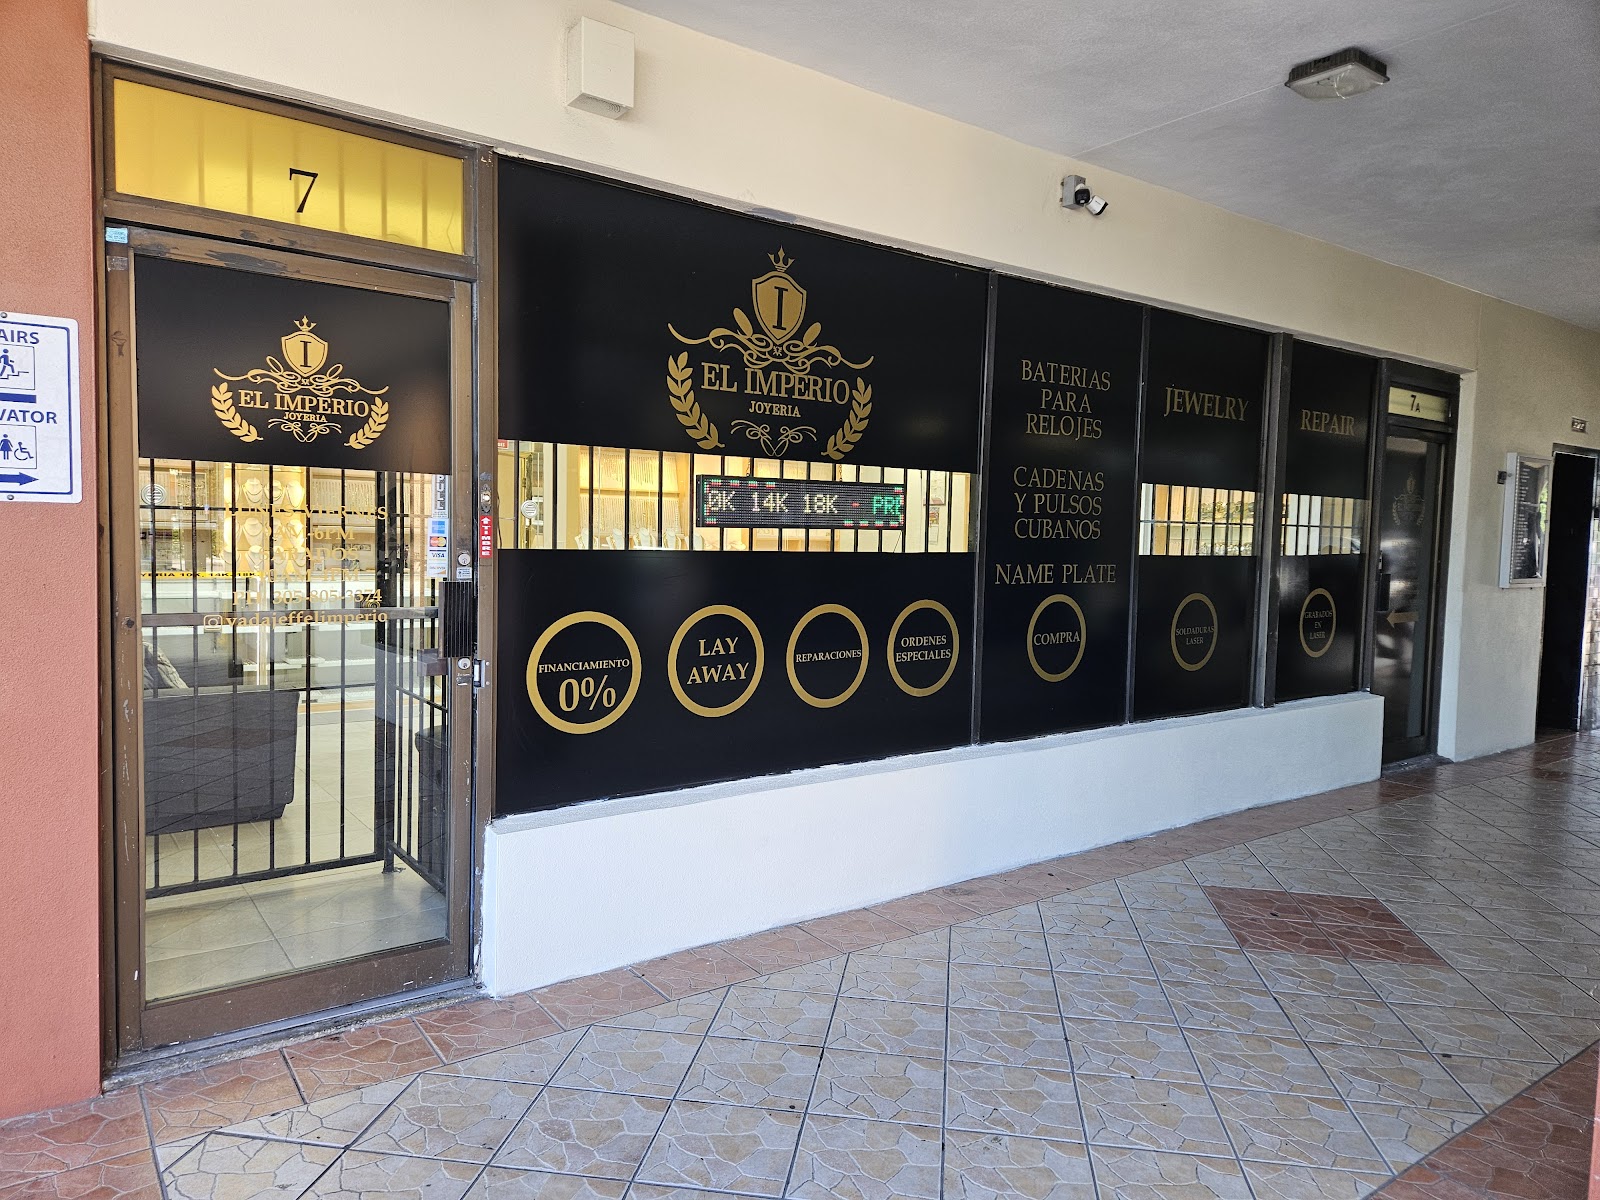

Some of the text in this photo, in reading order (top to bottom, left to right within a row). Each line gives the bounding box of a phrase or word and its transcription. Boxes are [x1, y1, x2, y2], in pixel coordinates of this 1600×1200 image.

[289, 167, 319, 214] 7
[772, 285, 789, 331] I
[299, 340, 312, 368] I
[701, 362, 850, 405] EL IMPERIO
[1021, 359, 1111, 391] BATERIAS
[238, 389, 369, 418] EL IMPERIO
[749, 400, 801, 418] JOYERIA
[1040, 388, 1092, 414] PARA
[1164, 386, 1249, 422] JEWELRY
[1410, 394, 1421, 413] 7A
[283, 411, 328, 423] JOYERIA
[1026, 412, 1102, 441] RELOJES
[1300, 409, 1355, 437] REPAIR
[1013, 465, 1105, 492] CADENAS
[752, 491, 789, 513] 14K
[803, 493, 838, 514] 18K
[1014, 492, 1102, 516] Y PULSOS
[1014, 517, 1101, 540] CUBANOS
[481, 525, 492, 556] TIMBRE
[995, 563, 1117, 585] NAME PLATE
[273, 588, 383, 605] 305-805-3374
[1175, 625, 1215, 636] SOLDADURAS
[1314, 621, 1323, 629] EN
[698, 636, 739, 657] LAY
[901, 635, 947, 648] ORDENES
[1033, 630, 1081, 646] COMPRA
[1186, 636, 1204, 646] LASER
[538, 658, 630, 674] FINANCIAMIENTO
[795, 649, 862, 663] REPARACIONES
[895, 648, 951, 663] ESPECIALES
[686, 662, 750, 685] AWAY
[558, 674, 617, 713] 0%
